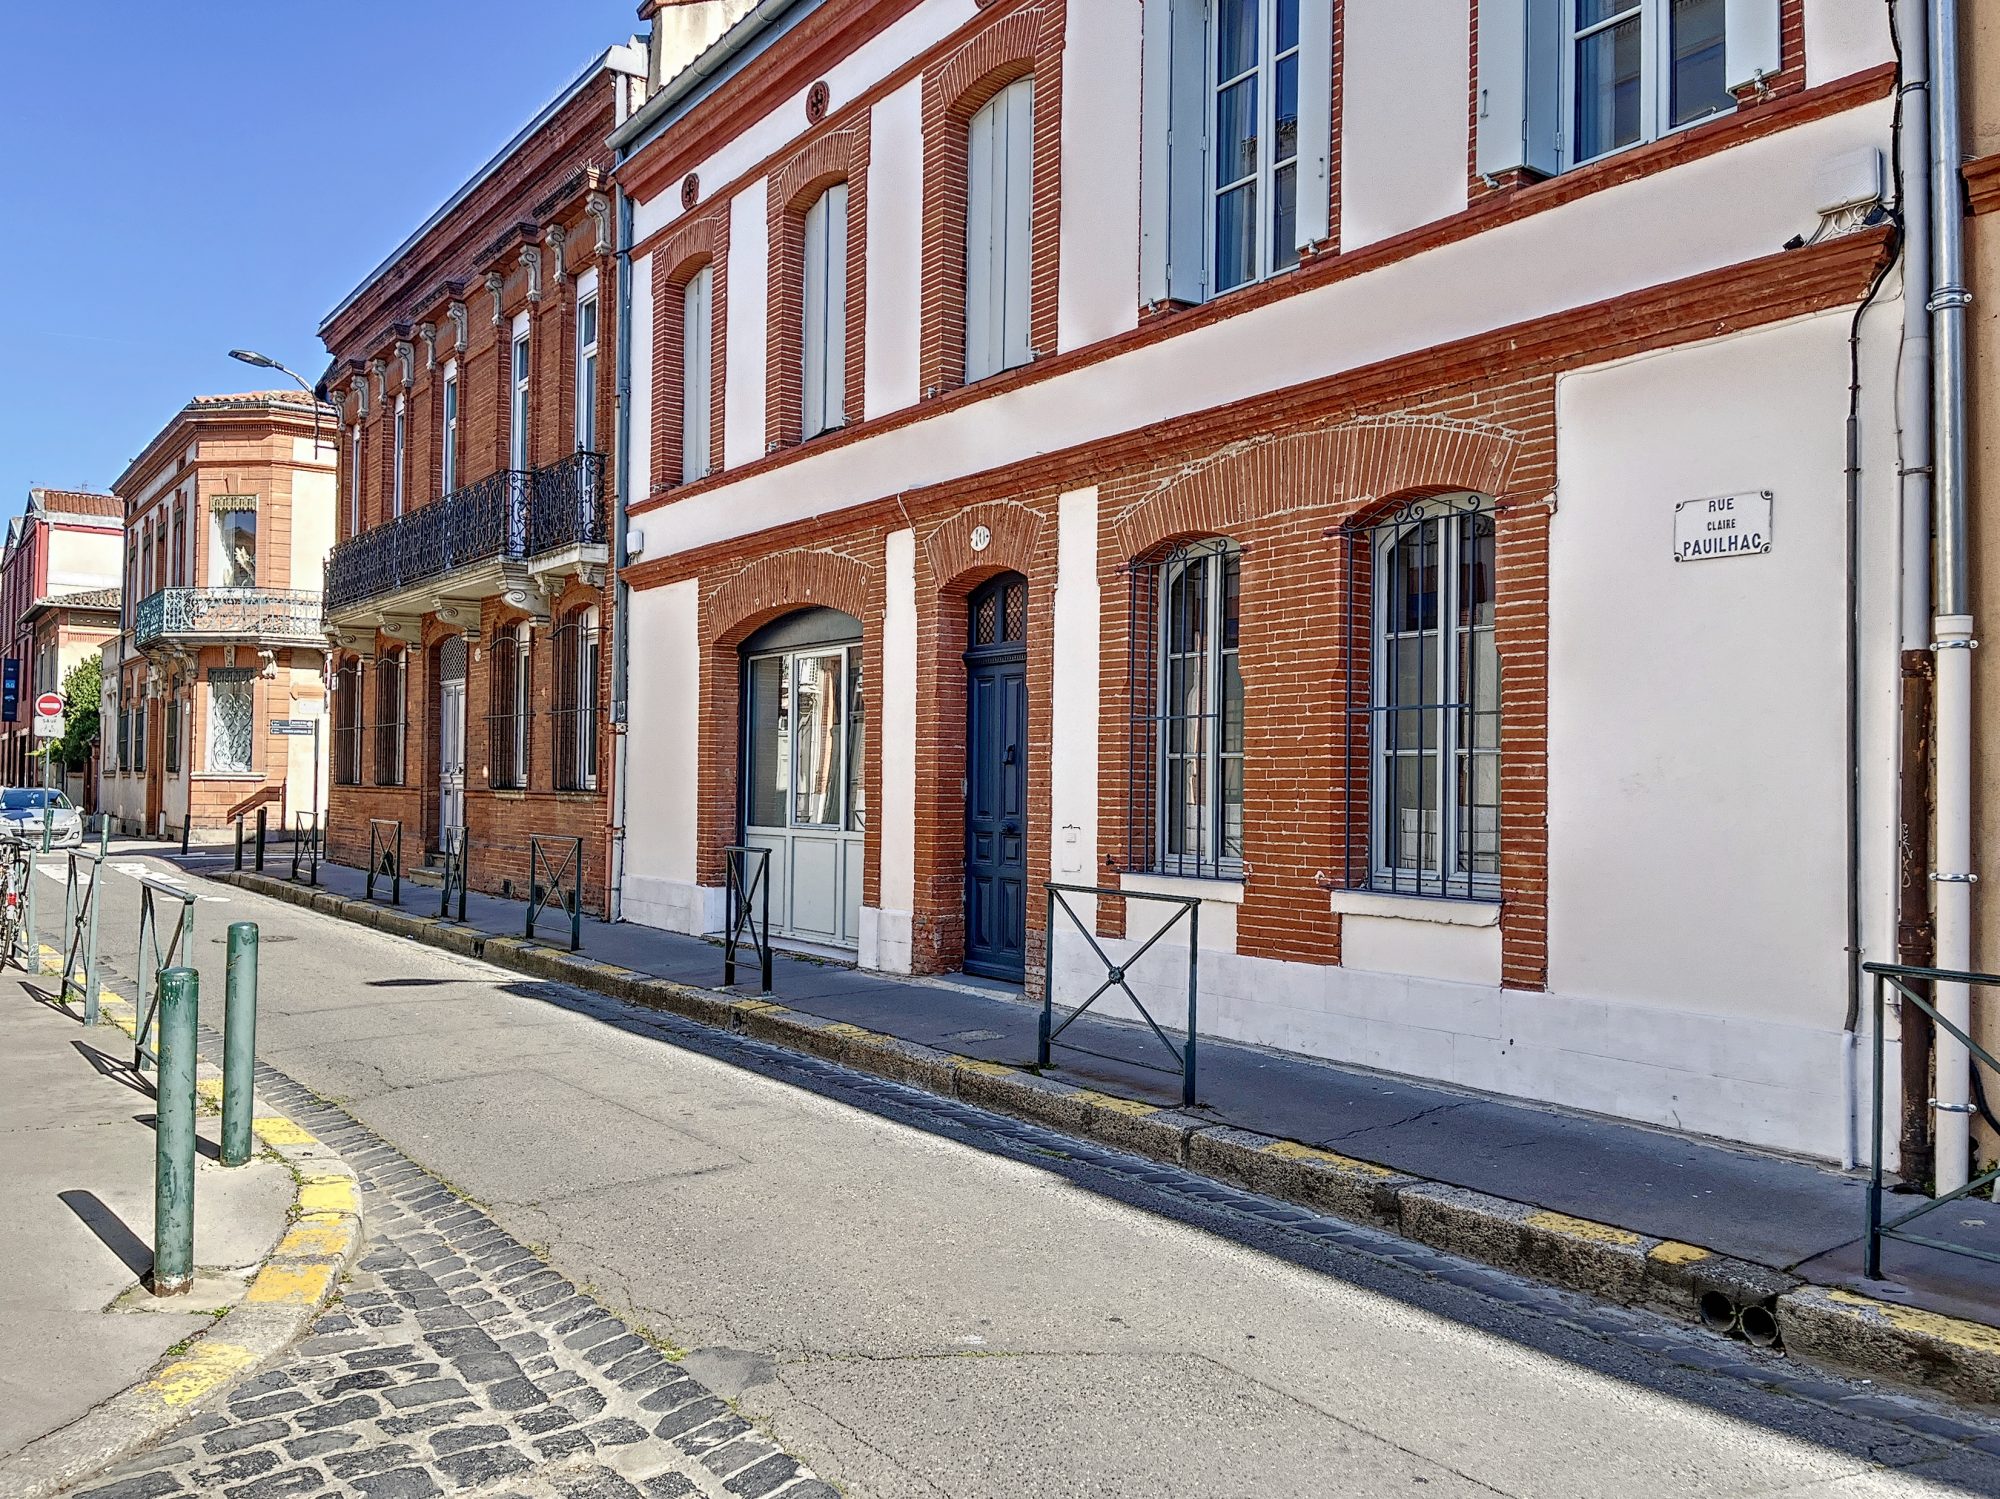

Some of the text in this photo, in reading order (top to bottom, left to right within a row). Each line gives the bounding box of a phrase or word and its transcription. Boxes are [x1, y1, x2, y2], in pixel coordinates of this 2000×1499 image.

[1708, 498, 1735, 513] RUE
[1707, 518, 1736, 532] CLAIRE
[975, 527, 986, 547] 10
[1683, 533, 1762, 557] PAUILHAC
